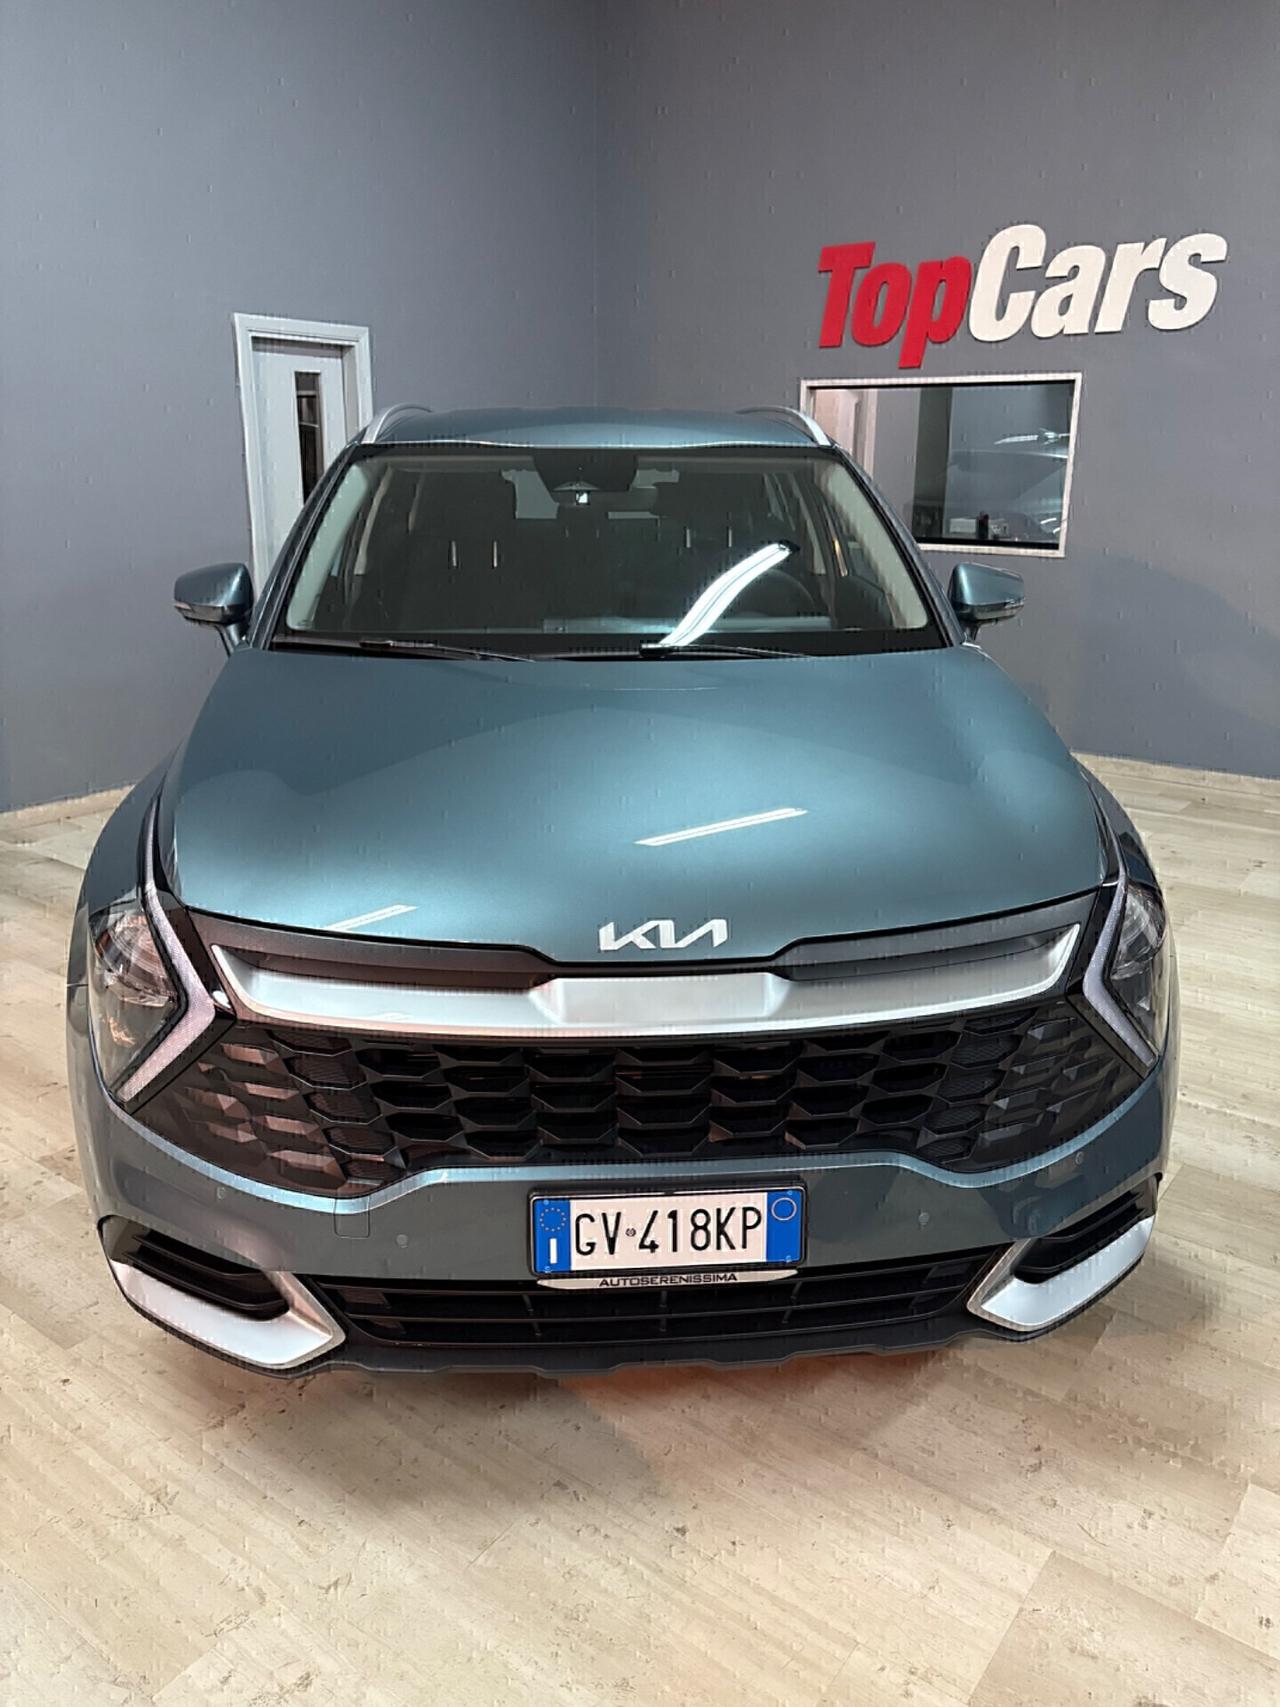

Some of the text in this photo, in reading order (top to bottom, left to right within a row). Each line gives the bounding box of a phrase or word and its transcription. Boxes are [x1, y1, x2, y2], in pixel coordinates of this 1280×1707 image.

[599, 918, 728, 951] KIA
[574, 1206, 762, 1256] GV 418KP
[599, 1272, 738, 1288] AUTOSERENISSIMA
